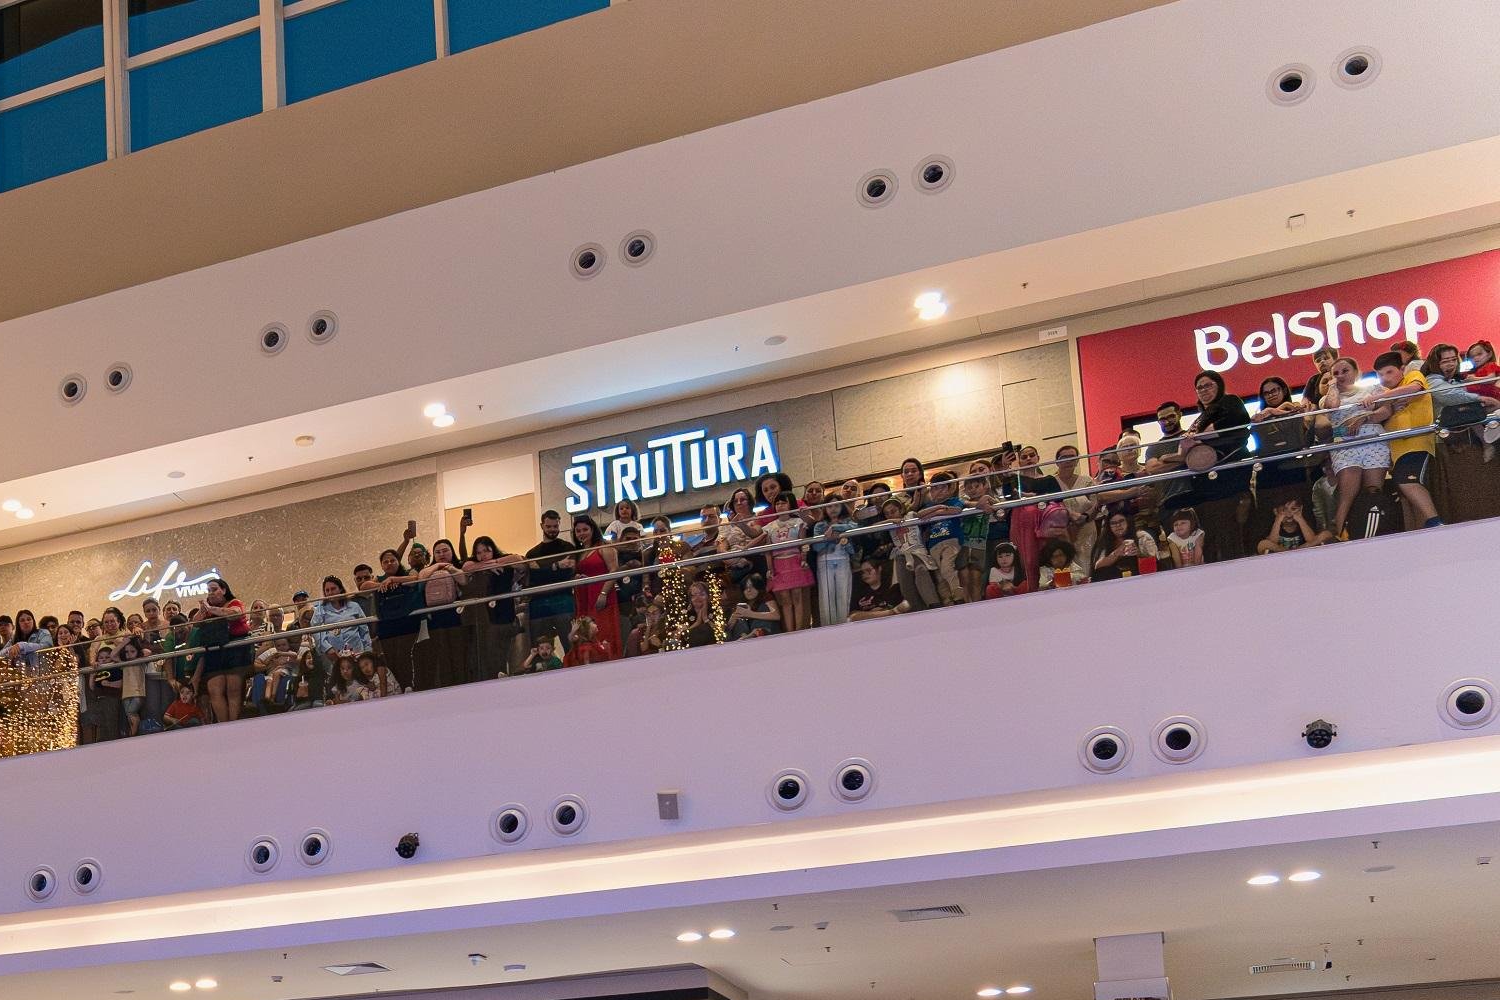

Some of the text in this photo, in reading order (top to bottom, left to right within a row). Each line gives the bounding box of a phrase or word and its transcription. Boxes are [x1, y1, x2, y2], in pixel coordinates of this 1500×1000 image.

[1194, 298, 1440, 373] BelShop
[564, 428, 779, 514] STRUTURA
[108, 560, 221, 602] Life
[176, 582, 209, 598] VIVAR
